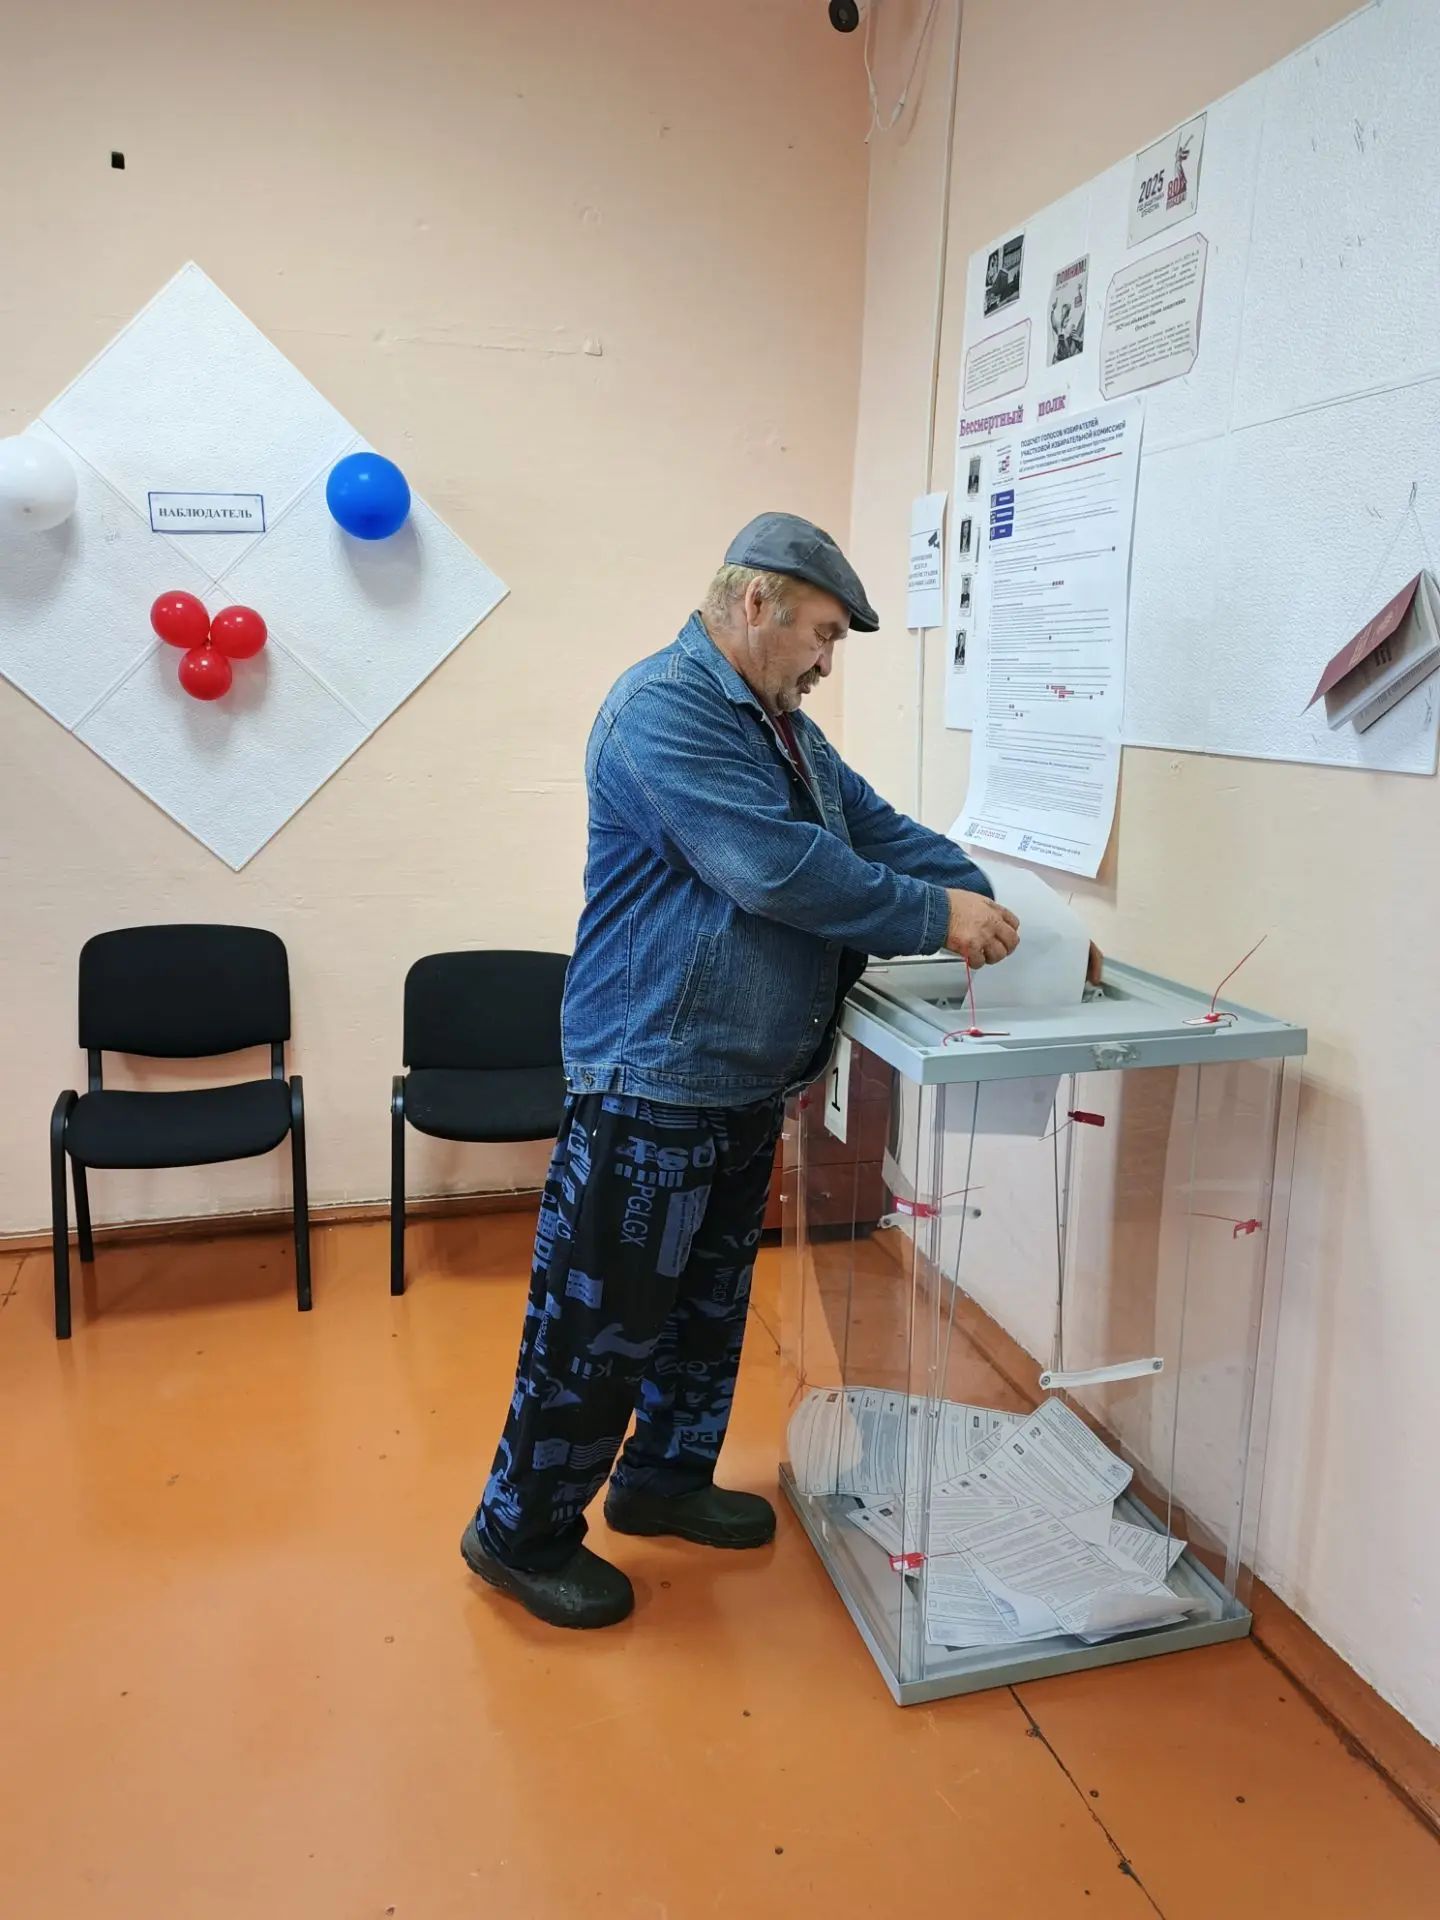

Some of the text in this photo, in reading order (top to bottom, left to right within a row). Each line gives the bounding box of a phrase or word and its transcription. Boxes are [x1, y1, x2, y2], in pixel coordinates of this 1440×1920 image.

[1138, 169, 1164, 203] 2025
[959, 404, 1024, 436] Бессмертный
[159, 508, 252, 519] НАБЛЮДАТЕЛЬ
[832, 1067, 840, 1112] 1
